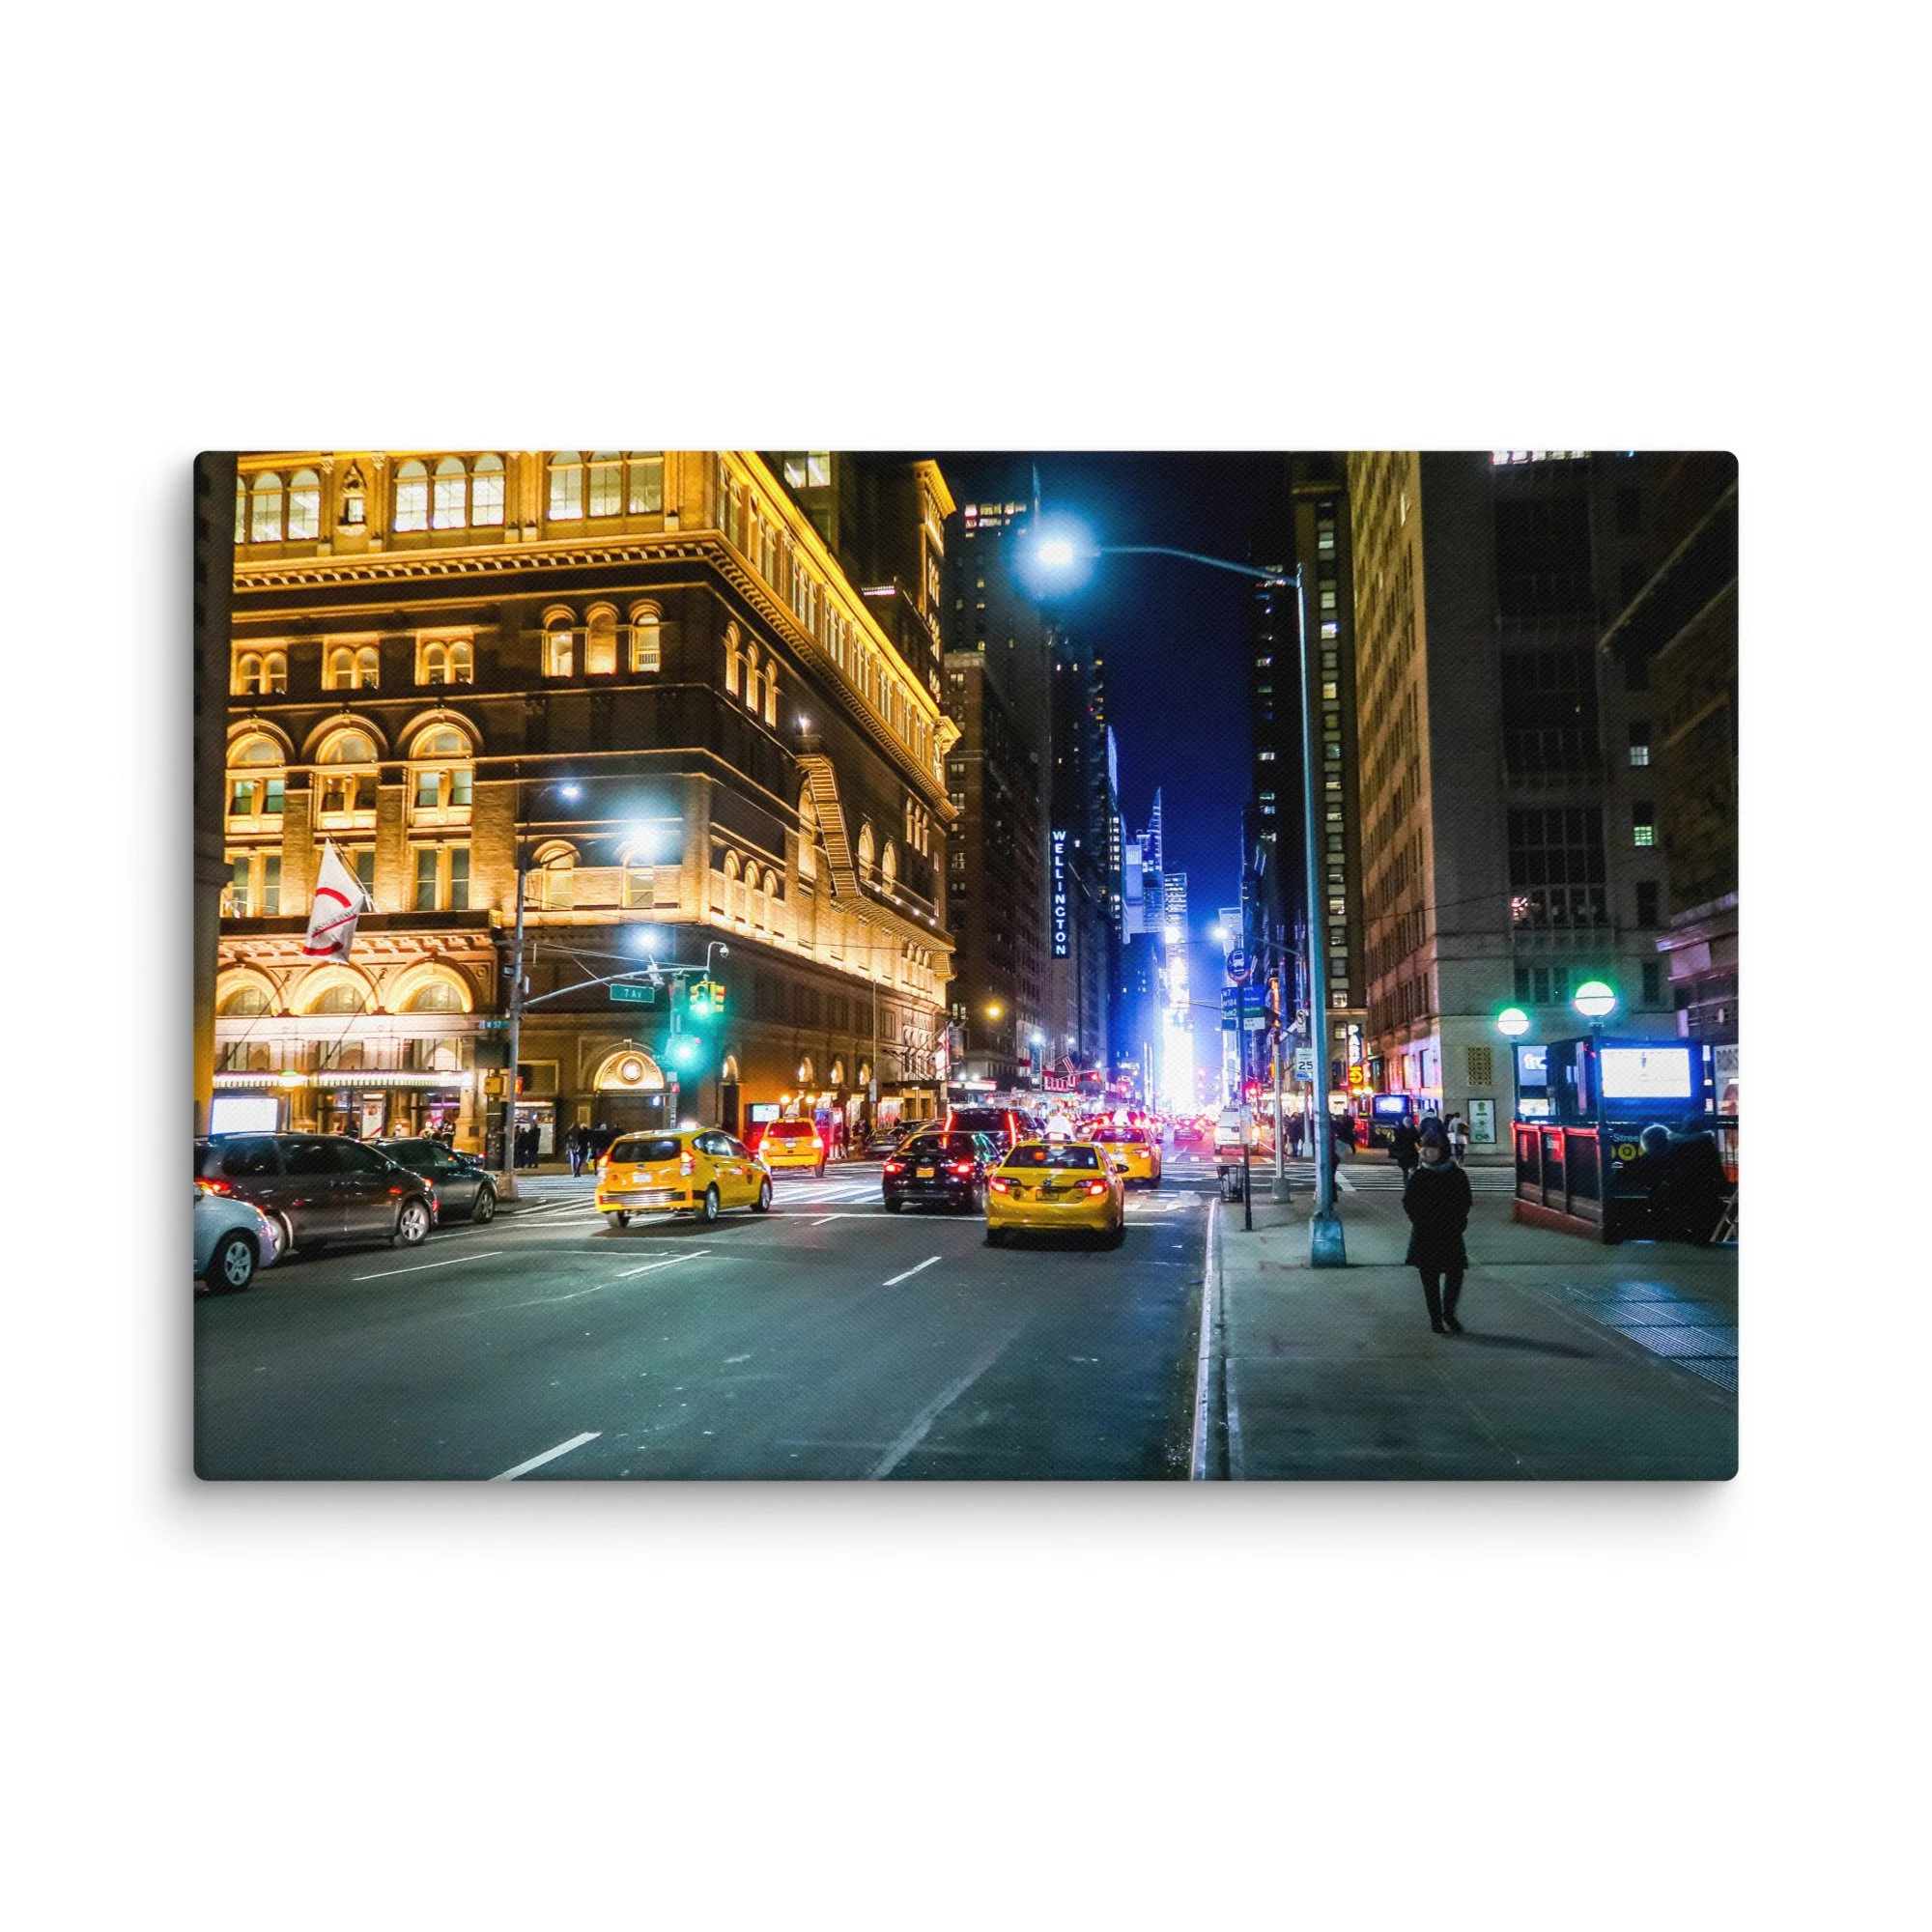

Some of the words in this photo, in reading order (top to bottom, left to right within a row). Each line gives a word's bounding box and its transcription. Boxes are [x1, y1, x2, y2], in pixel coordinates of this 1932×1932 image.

[1052, 831, 1066, 955] WELLINGTON
[623, 988, 629, 998] 7
[1298, 1061, 1314, 1070] 25
[1613, 1133, 1641, 1143] Stree
